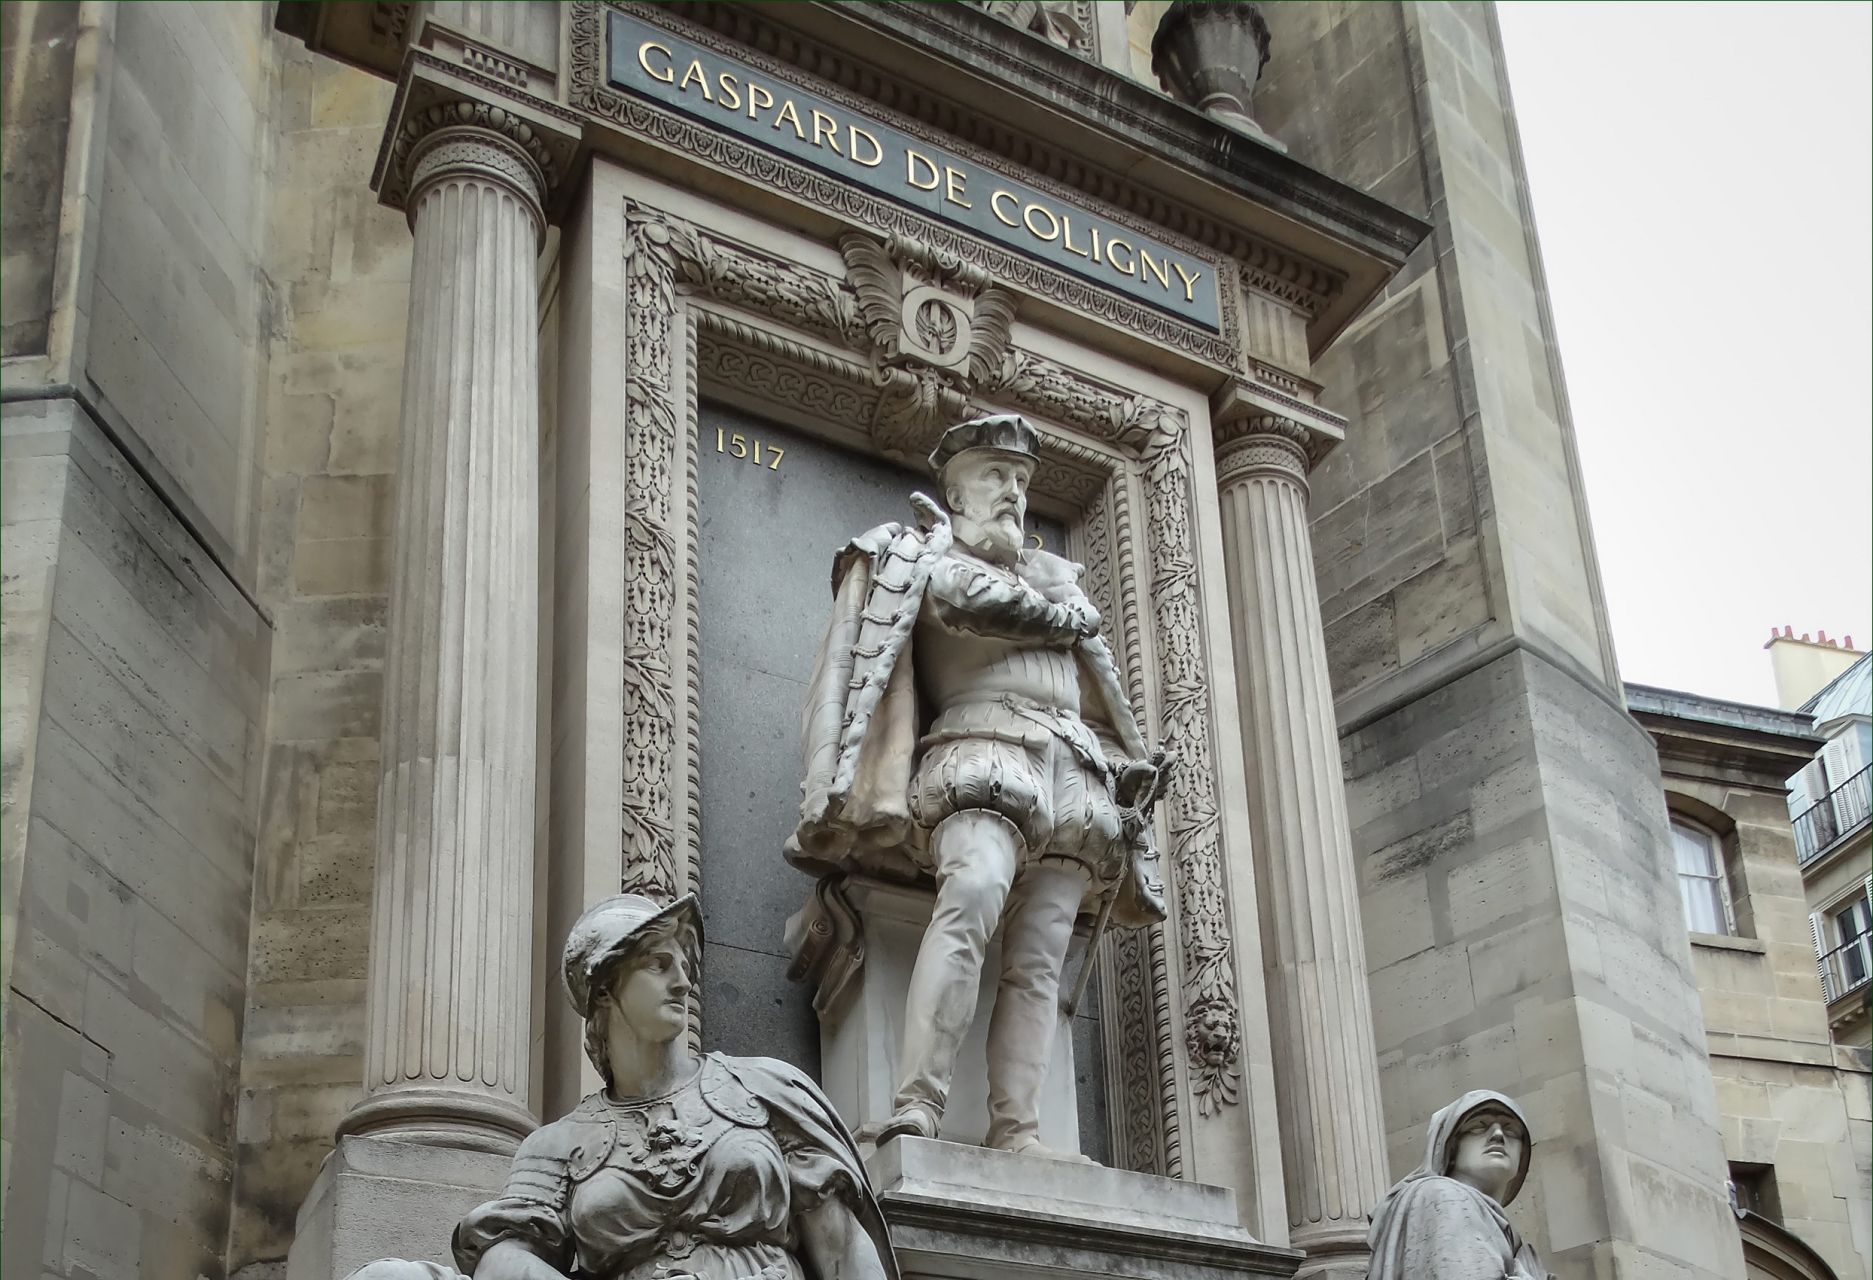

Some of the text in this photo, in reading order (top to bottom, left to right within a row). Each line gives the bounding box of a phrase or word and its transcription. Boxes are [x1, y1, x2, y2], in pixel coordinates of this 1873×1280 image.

[638, 41, 1202, 302] GASPARD DE COLIGNY
[714, 427, 786, 471] 1517
